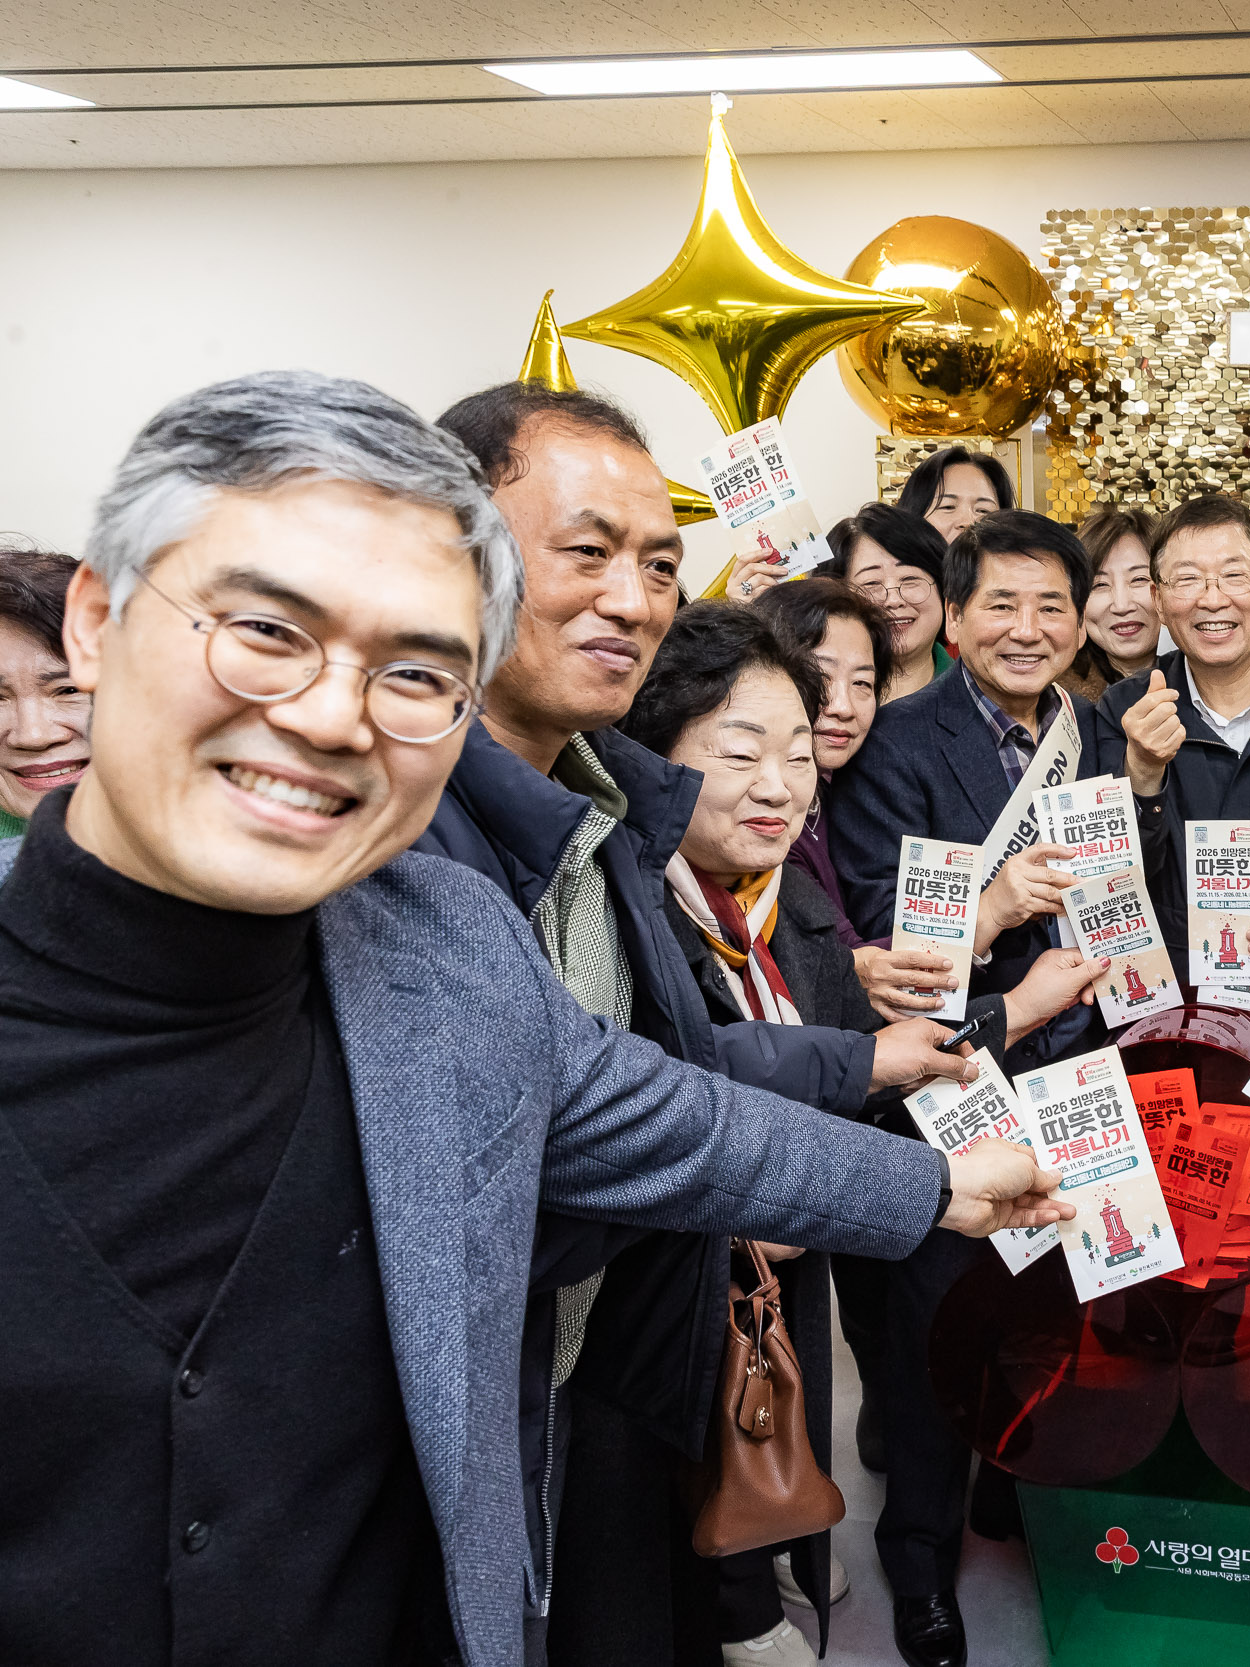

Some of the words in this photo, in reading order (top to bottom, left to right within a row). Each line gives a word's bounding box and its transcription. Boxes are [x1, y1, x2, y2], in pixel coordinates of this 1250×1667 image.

[710, 471, 727, 485] 2026
[714, 465, 762, 500] 따뜻한
[721, 480, 767, 512] 겨울나기
[1063, 814, 1086, 825] 2026
[1088, 807, 1125, 821] 희망온돌
[1064, 818, 1127, 844] 따뜻한
[1196, 848, 1218, 857] 2026
[908, 866, 930, 877] 2026
[933, 870, 971, 883] 희망온돌
[905, 878, 970, 903] 따뜻한
[904, 898, 966, 918] 겨울나기
[1078, 904, 1100, 917] 2026
[1102, 891, 1139, 909] 희망온돌
[1080, 901, 1142, 933] 따뜻한
[1086, 917, 1147, 945] 겨울나기
[933, 1109, 958, 1130] 2026
[958, 1082, 998, 1114] 희망온돌
[1038, 1101, 1068, 1120] 2026
[1069, 1085, 1118, 1110] 희망온돌
[1148, 1097, 1184, 1111] 희망온돌
[939, 1094, 1010, 1150] 따뜻한
[1040, 1100, 1124, 1145] 따뜻한
[1048, 1124, 1131, 1165] 겨울나기
[1167, 1154, 1230, 1188] 따뜻한
[1173, 1145, 1195, 1158] 2026
[1198, 1152, 1233, 1171] 희망온돌
[1144, 1540, 1212, 1565] 사랑의
